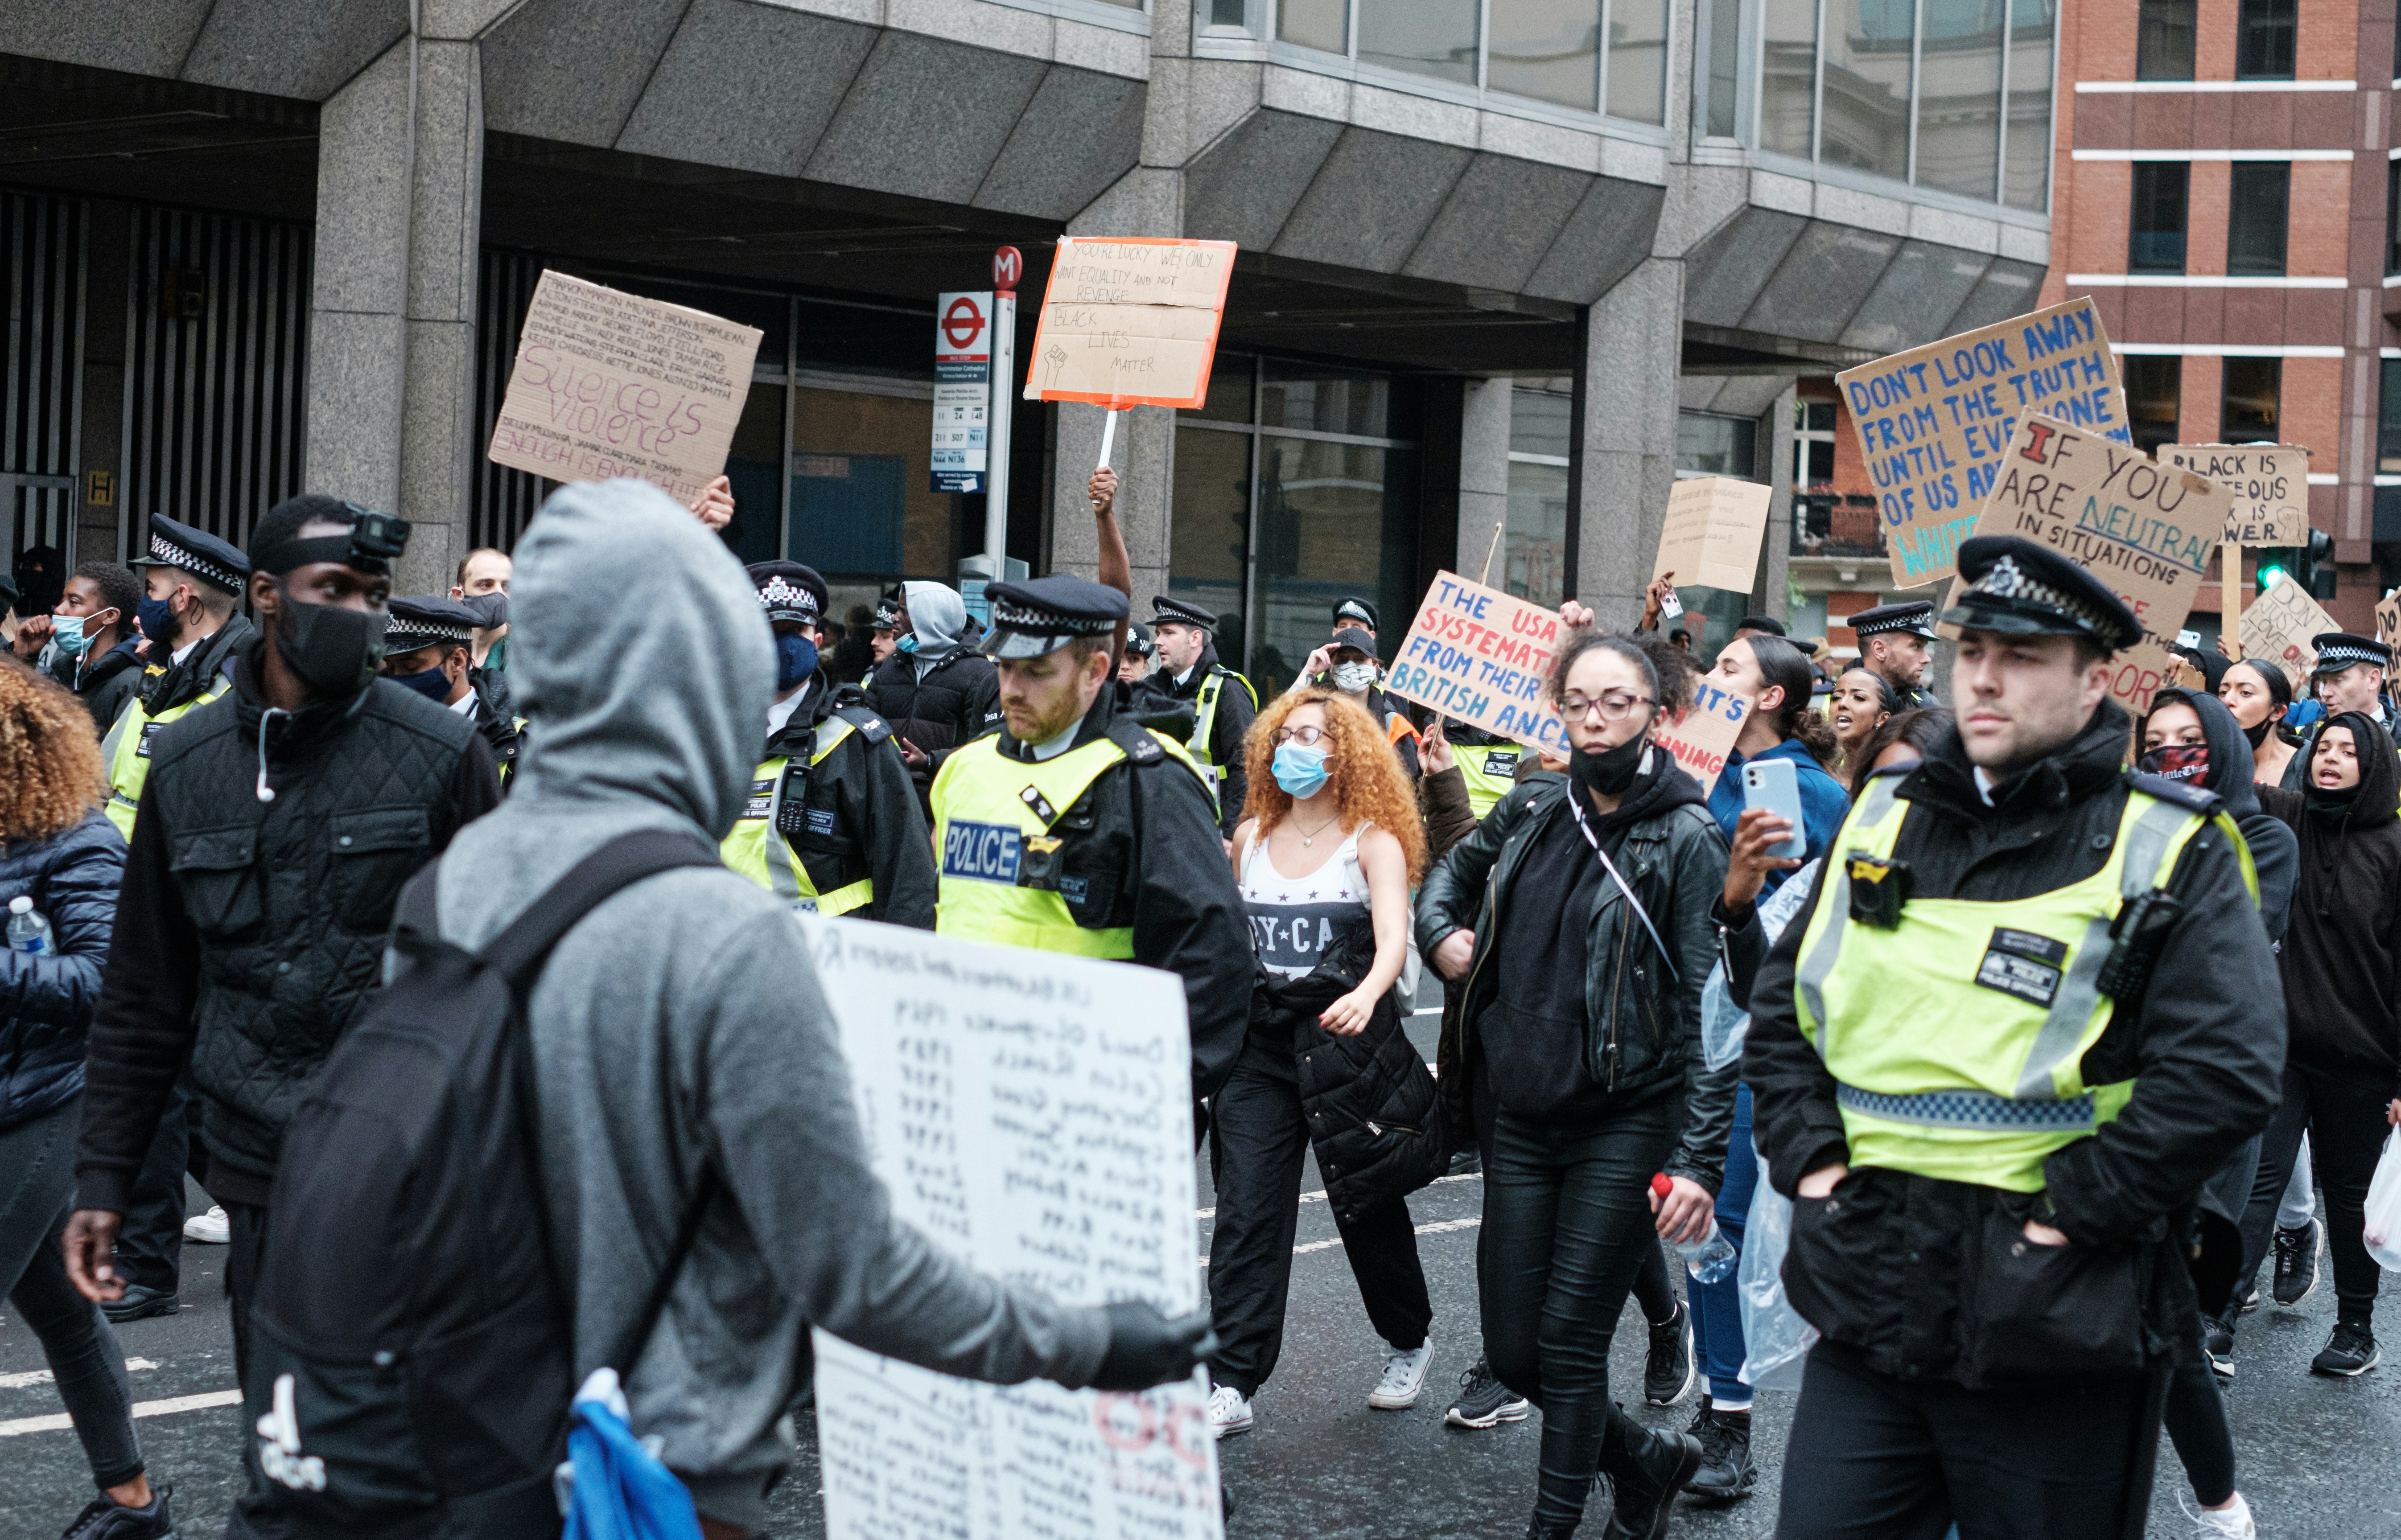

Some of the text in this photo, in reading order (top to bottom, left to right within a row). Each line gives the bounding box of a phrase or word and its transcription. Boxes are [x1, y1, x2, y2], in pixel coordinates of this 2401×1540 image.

[994, 253, 1015, 283] M
[1054, 265, 1178, 286] WANT EQUALITY AND NOT
[1073, 243, 1214, 268] YOU'RE LUCKY WE ONLY
[1054, 311, 1098, 328] BLACK
[1077, 285, 1130, 302] REVENGE
[1088, 331, 1130, 349] LIVES
[1111, 357, 1156, 373] MATTER
[1849, 308, 2095, 417] DON'T LOOK AWAY
[1862, 350, 2106, 454] FROM THE TRUTH
[493, 427, 574, 468] ENOUGH
[577, 452, 597, 475] IS
[951, 434, 963, 442] 507
[1873, 386, 2113, 488] UNTIL EVEONE
[2020, 420, 2187, 513] IF YOU
[2260, 455, 2276, 475] IS
[1882, 459, 2003, 527] OF US AR
[1998, 469, 2209, 571] ARE NEUTRAL
[2016, 511, 2180, 586] IN SITUATIONS
[1438, 579, 1558, 643] THE USA
[1421, 607, 1559, 678] SYSTEMATI
[1391, 661, 1571, 752] BRITISH ANCE
[1407, 635, 1473, 678] FROM
[1480, 659, 1541, 702] THEIR
[1695, 683, 1745, 721] IT'S
[946, 823, 1019, 878] POLICE
